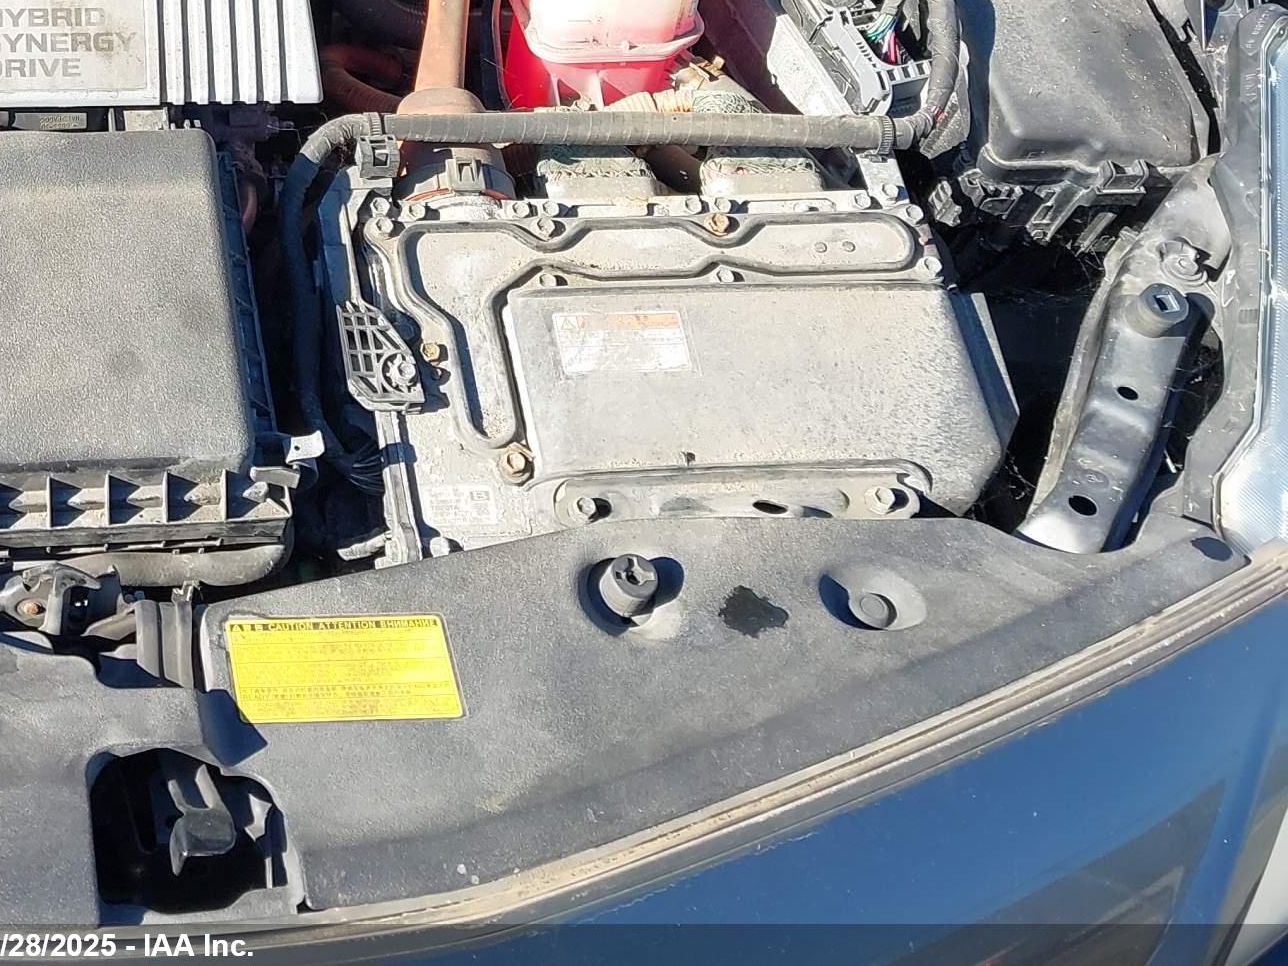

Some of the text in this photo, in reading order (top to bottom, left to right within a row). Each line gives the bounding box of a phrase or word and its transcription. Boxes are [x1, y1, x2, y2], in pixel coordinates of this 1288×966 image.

[268, 622, 313, 632] CAUTION
[318, 620, 376, 631] ATTENTION
[380, 619, 437, 629] ВНИМАНИЕ
